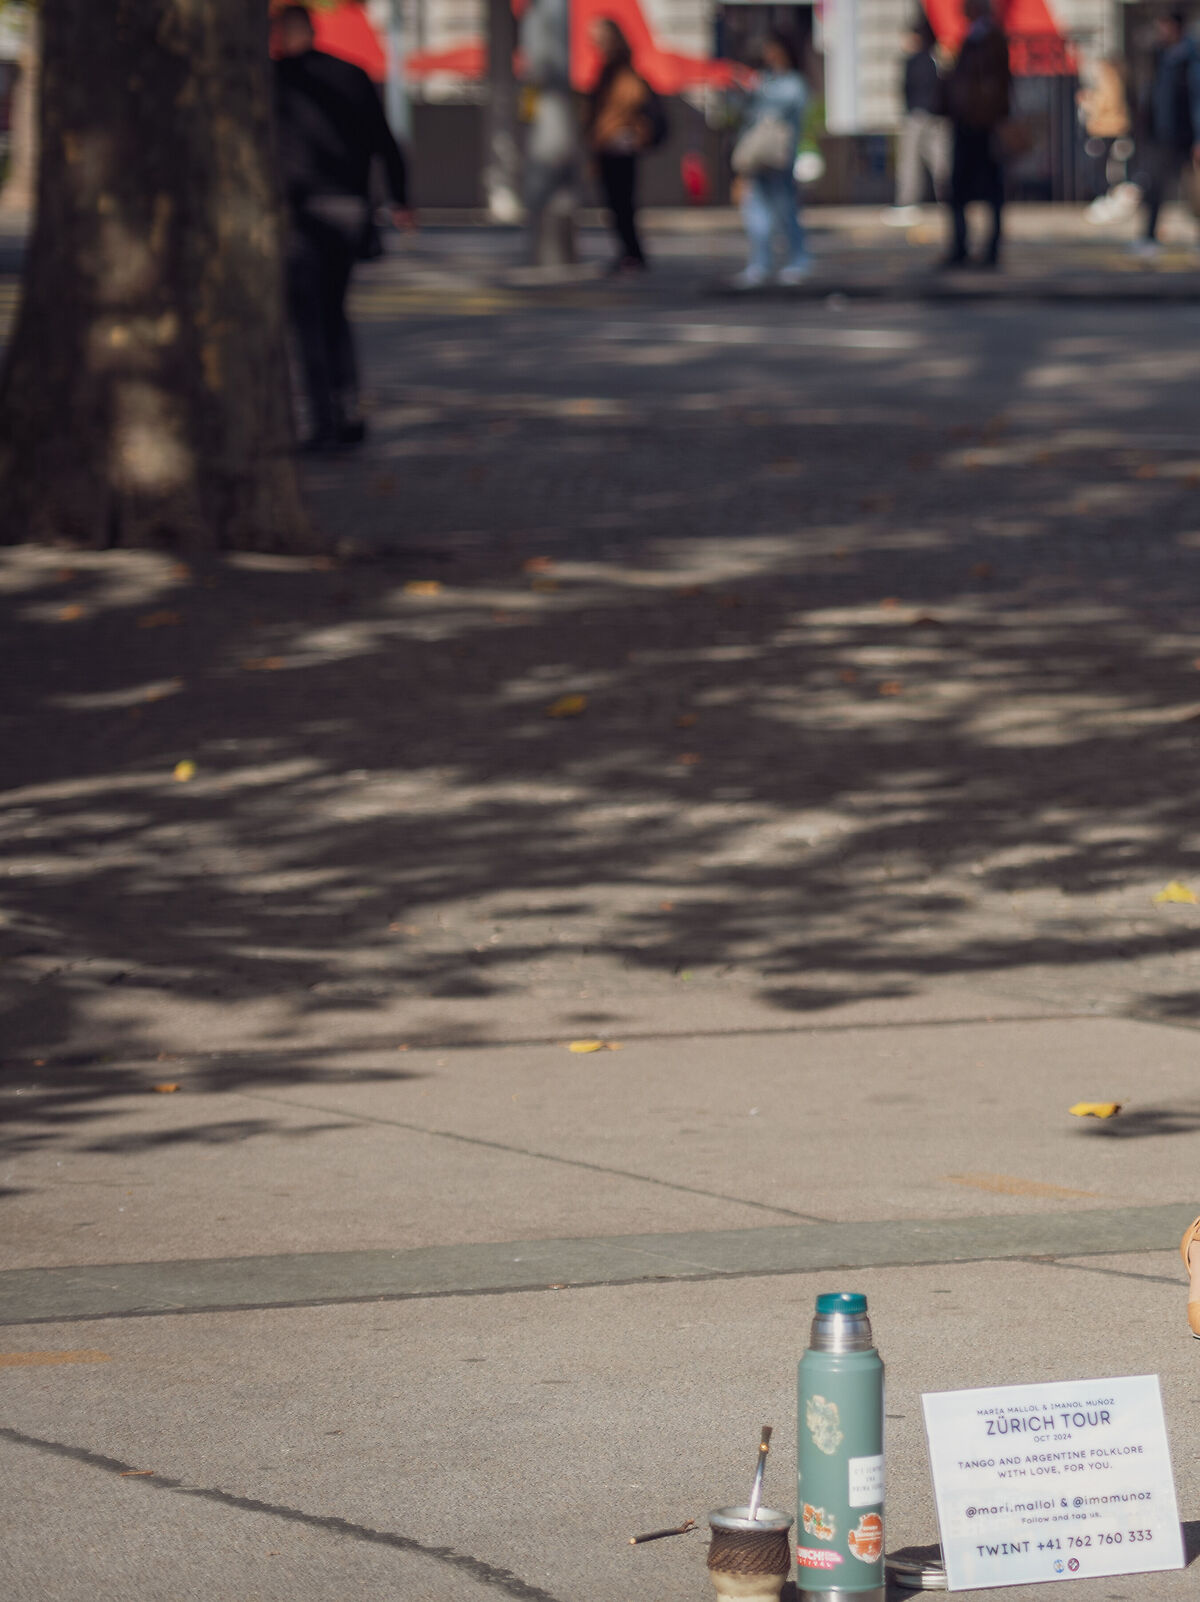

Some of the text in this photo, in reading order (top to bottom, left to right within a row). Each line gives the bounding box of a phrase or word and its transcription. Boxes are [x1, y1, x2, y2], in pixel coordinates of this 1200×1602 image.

[985, 1410, 1111, 1436] ZÜRICH TOUR
[1033, 1433, 1072, 1443] OCT 2024
[958, 1445, 1144, 1470] TANGO AND ARGENTINE FOLKLORE
[998, 1461, 1113, 1479] WITH LOVE, FOR YOU.
[965, 1491, 1152, 1519] @mari.mallol & @imamunoz
[1022, 1516, 1050, 1525] Follow
[1052, 1513, 1069, 1522] and
[1072, 1512, 1087, 1521] tag
[976, 1529, 1153, 1558] TWINT +41 762 760 333
